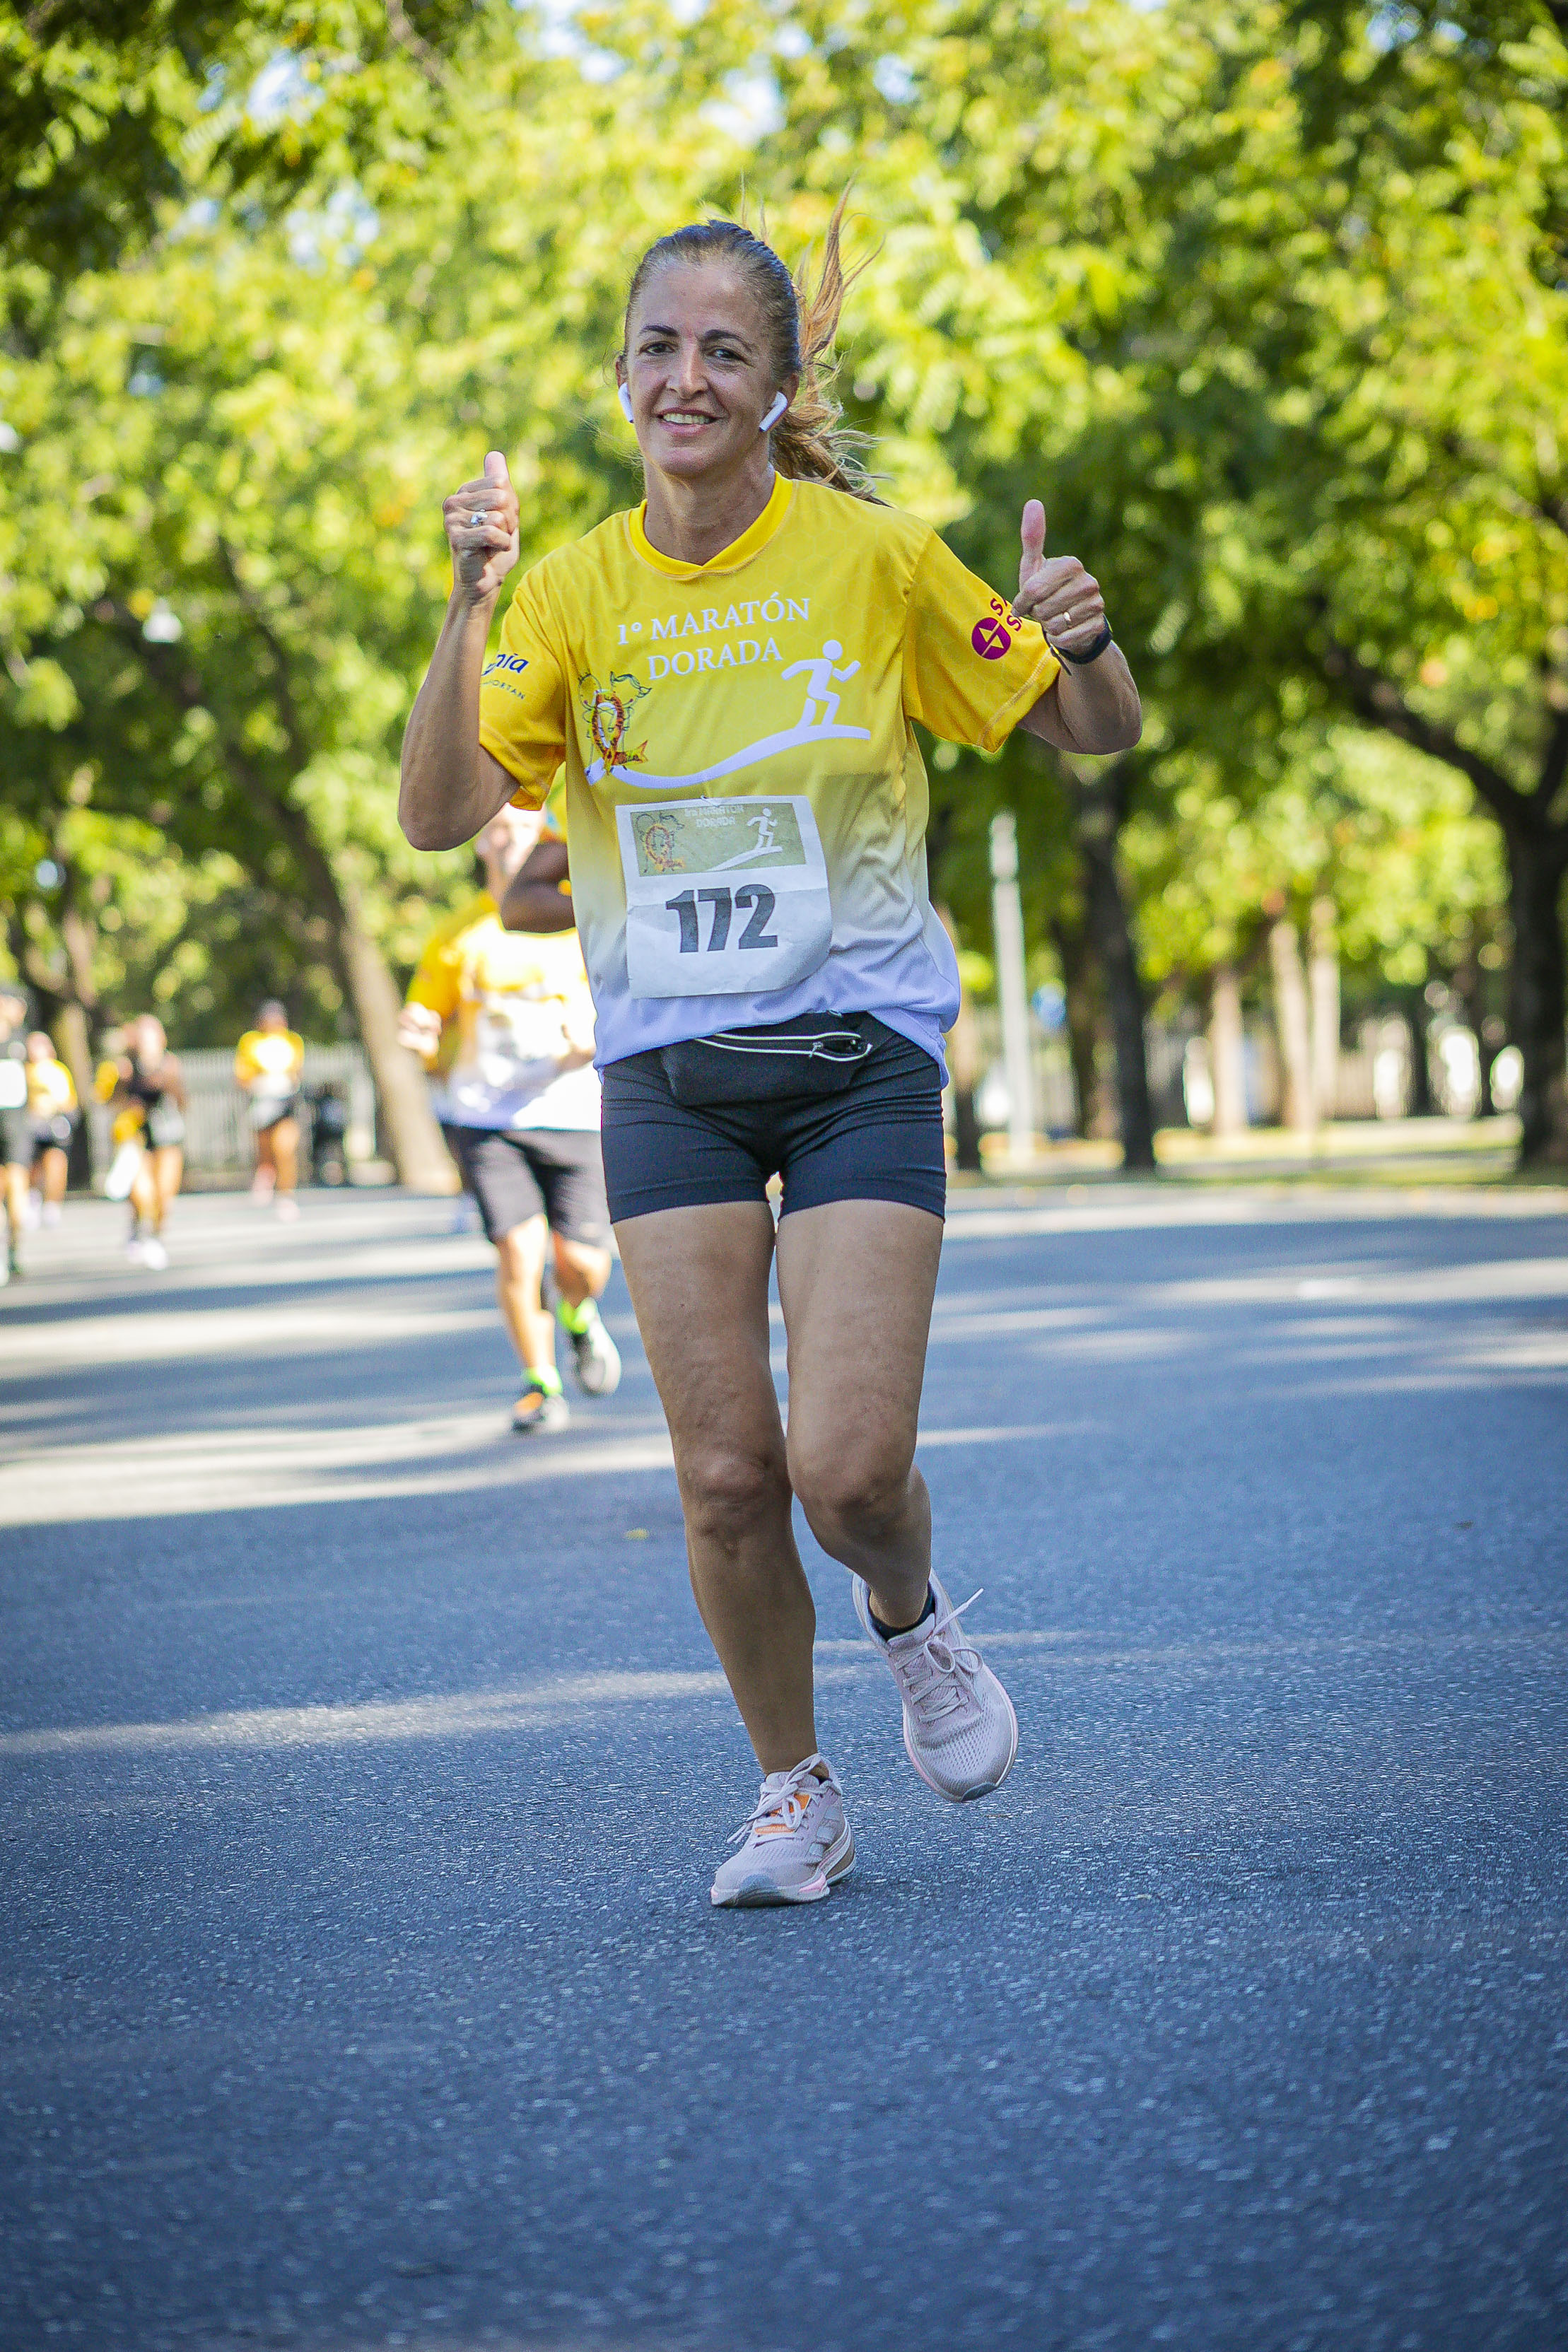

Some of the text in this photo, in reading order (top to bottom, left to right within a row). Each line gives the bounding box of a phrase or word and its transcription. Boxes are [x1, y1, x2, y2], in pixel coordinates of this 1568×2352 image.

[650, 592, 811, 640] MARATÓN
[648, 637, 783, 680] DORADA
[665, 884, 778, 953] 172
